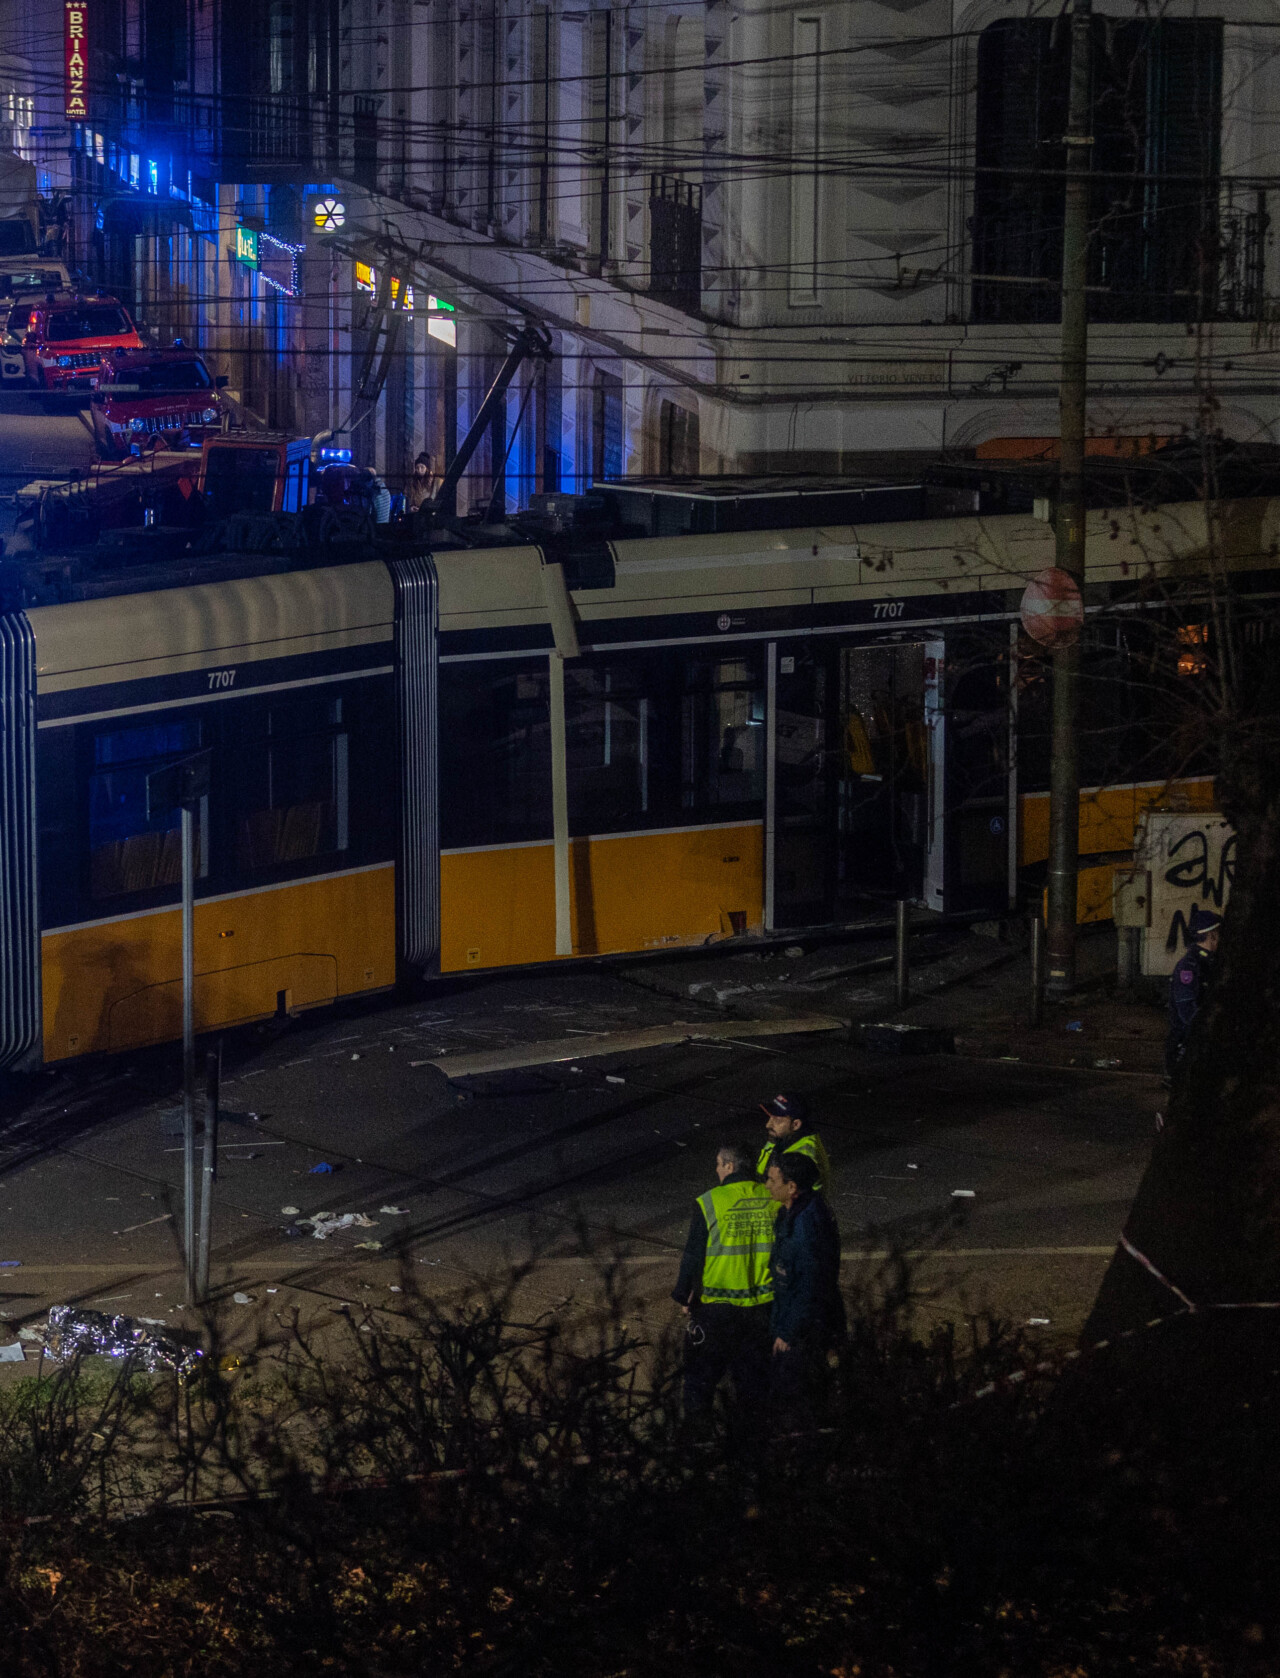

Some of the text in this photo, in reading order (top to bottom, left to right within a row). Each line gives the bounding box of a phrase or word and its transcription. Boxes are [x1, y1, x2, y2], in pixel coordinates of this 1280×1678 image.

[69, 11, 85, 107] BRIANZA
[872, 602, 906, 619] 7707
[207, 669, 237, 689] 7707
